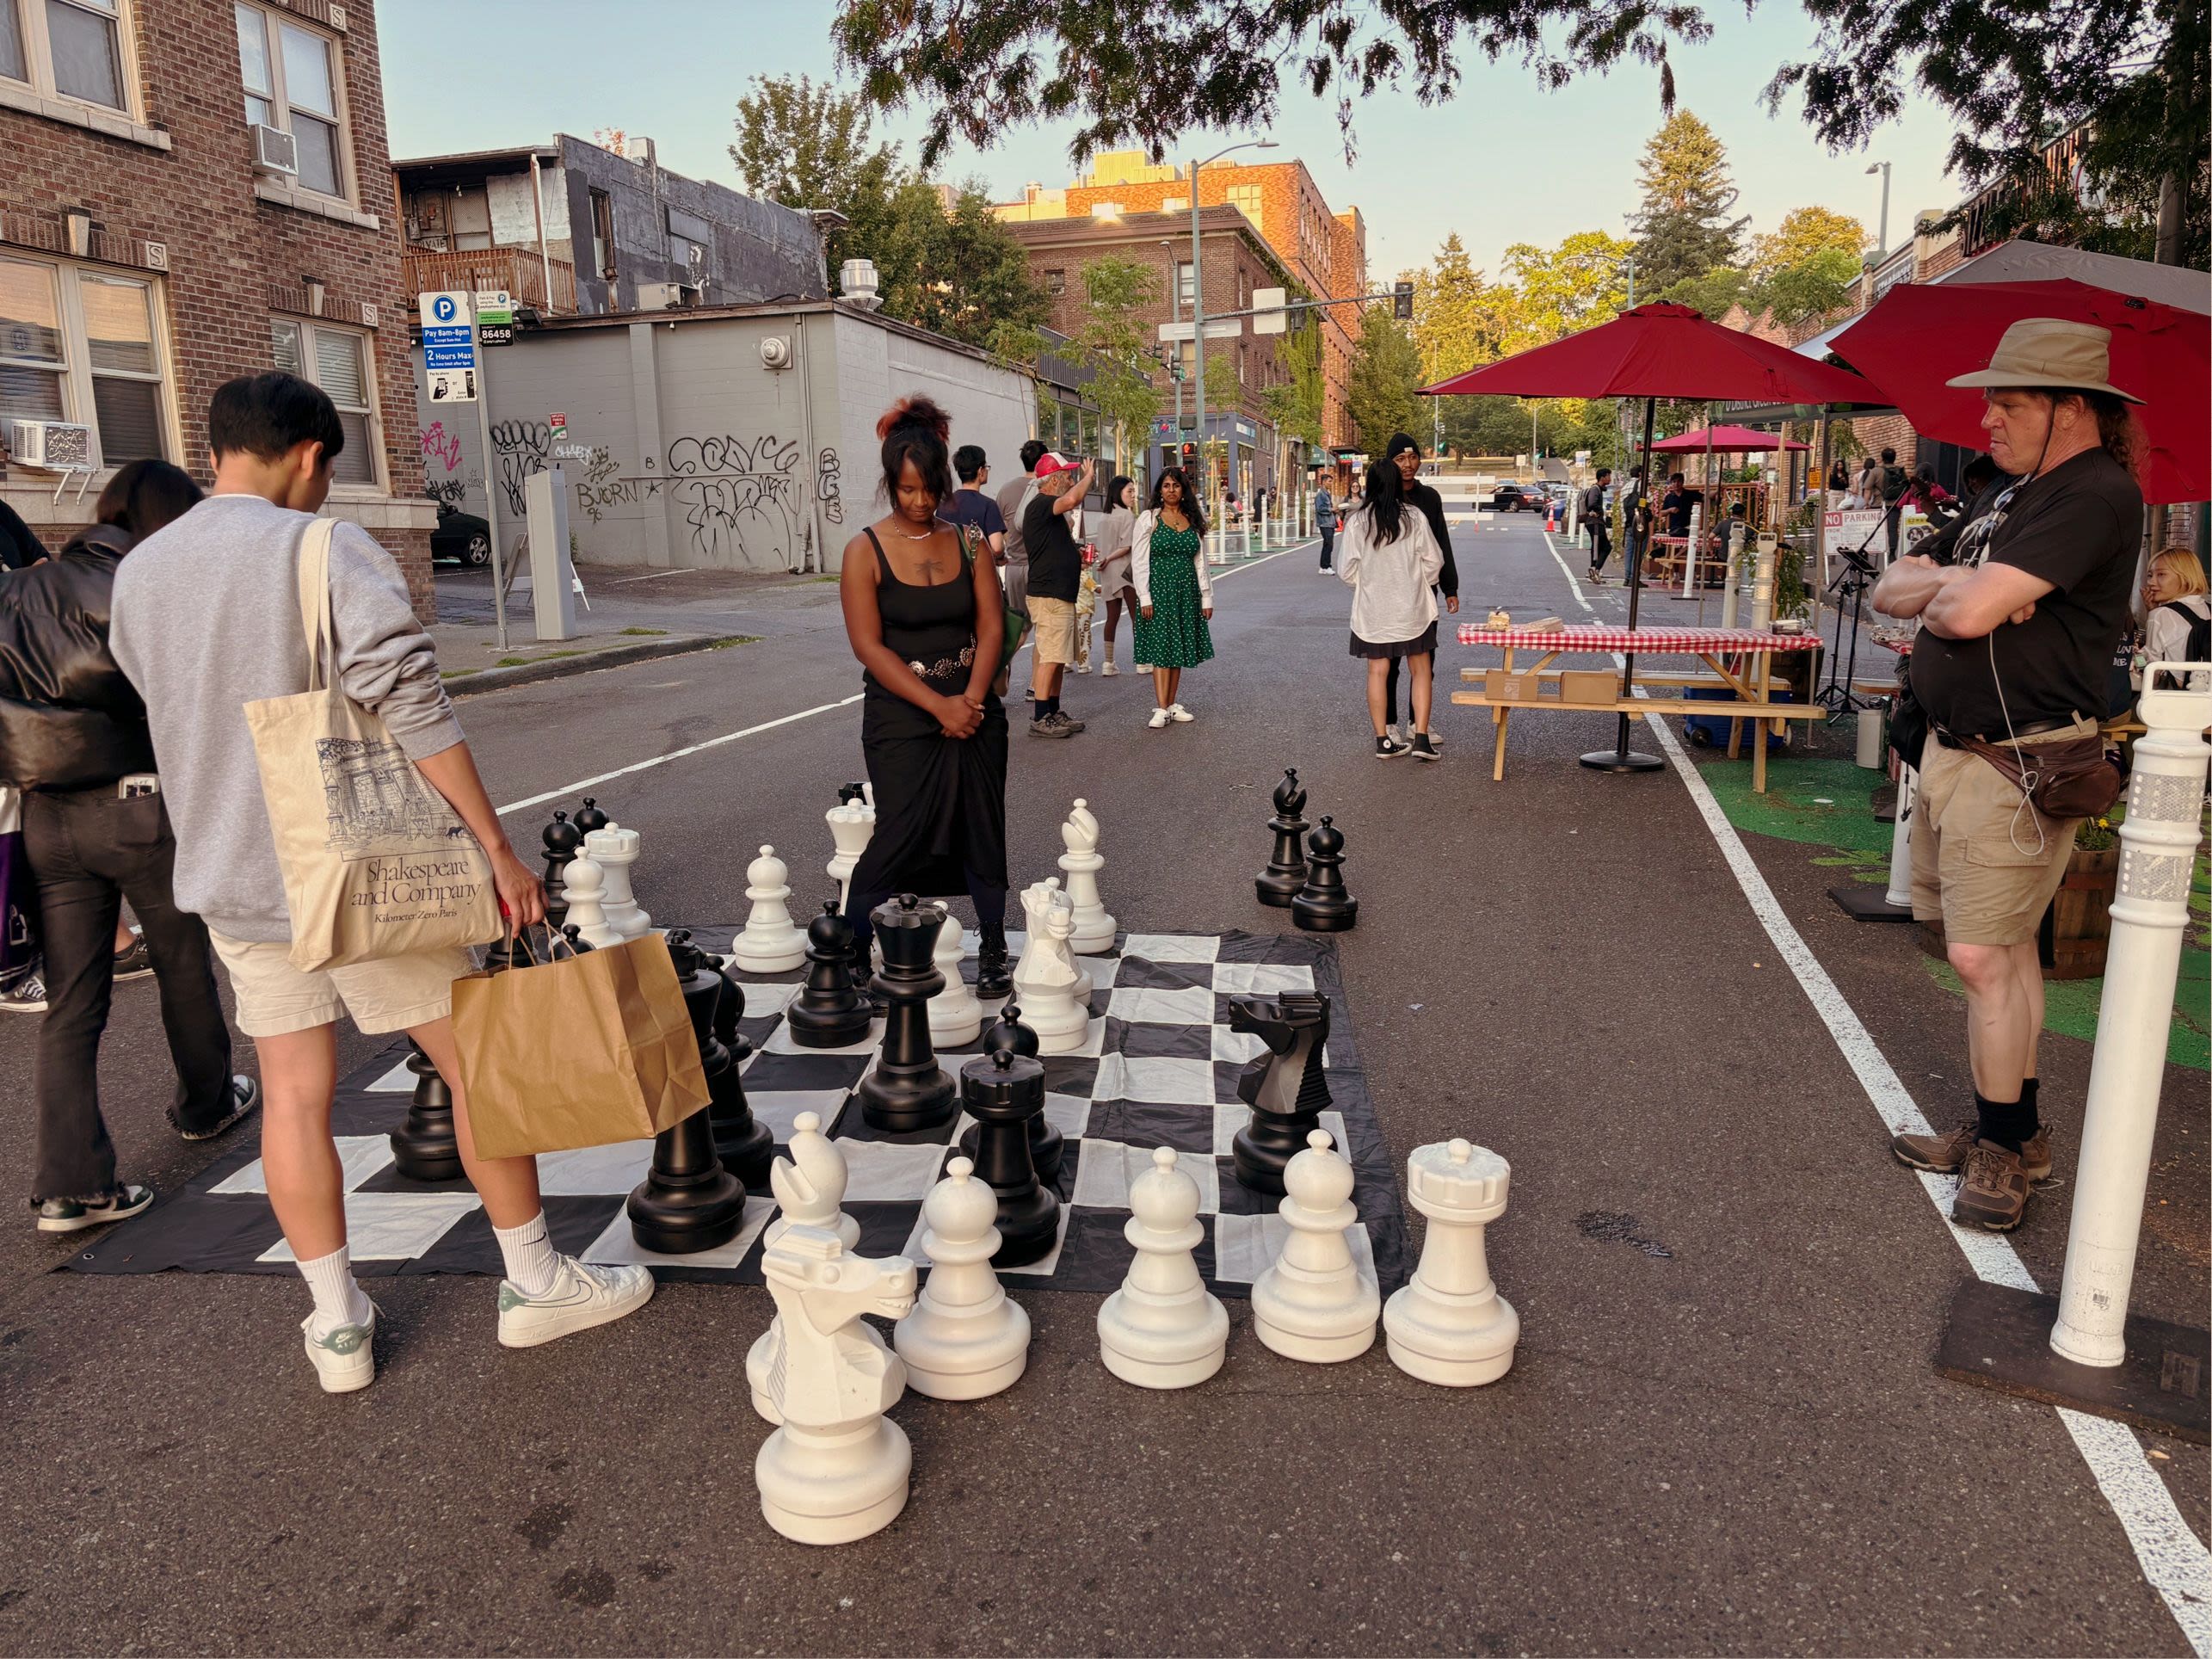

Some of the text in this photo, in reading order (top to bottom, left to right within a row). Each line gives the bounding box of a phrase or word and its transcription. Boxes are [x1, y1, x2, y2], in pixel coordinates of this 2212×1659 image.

[150, 246, 163, 267] S
[366, 306, 375, 323] S
[440, 300, 452, 318] P
[424, 328, 470, 338] Pay 8am-8pm
[482, 330, 511, 339] 86458
[427, 349, 434, 361] 2
[1826, 513, 1882, 525] NO PARKING
[2112, 657, 2127, 667] ME
[367, 857, 469, 885] Shakespeare
[352, 882, 481, 907] and Company
[374, 909, 458, 923] Kilometer Zero Paris
